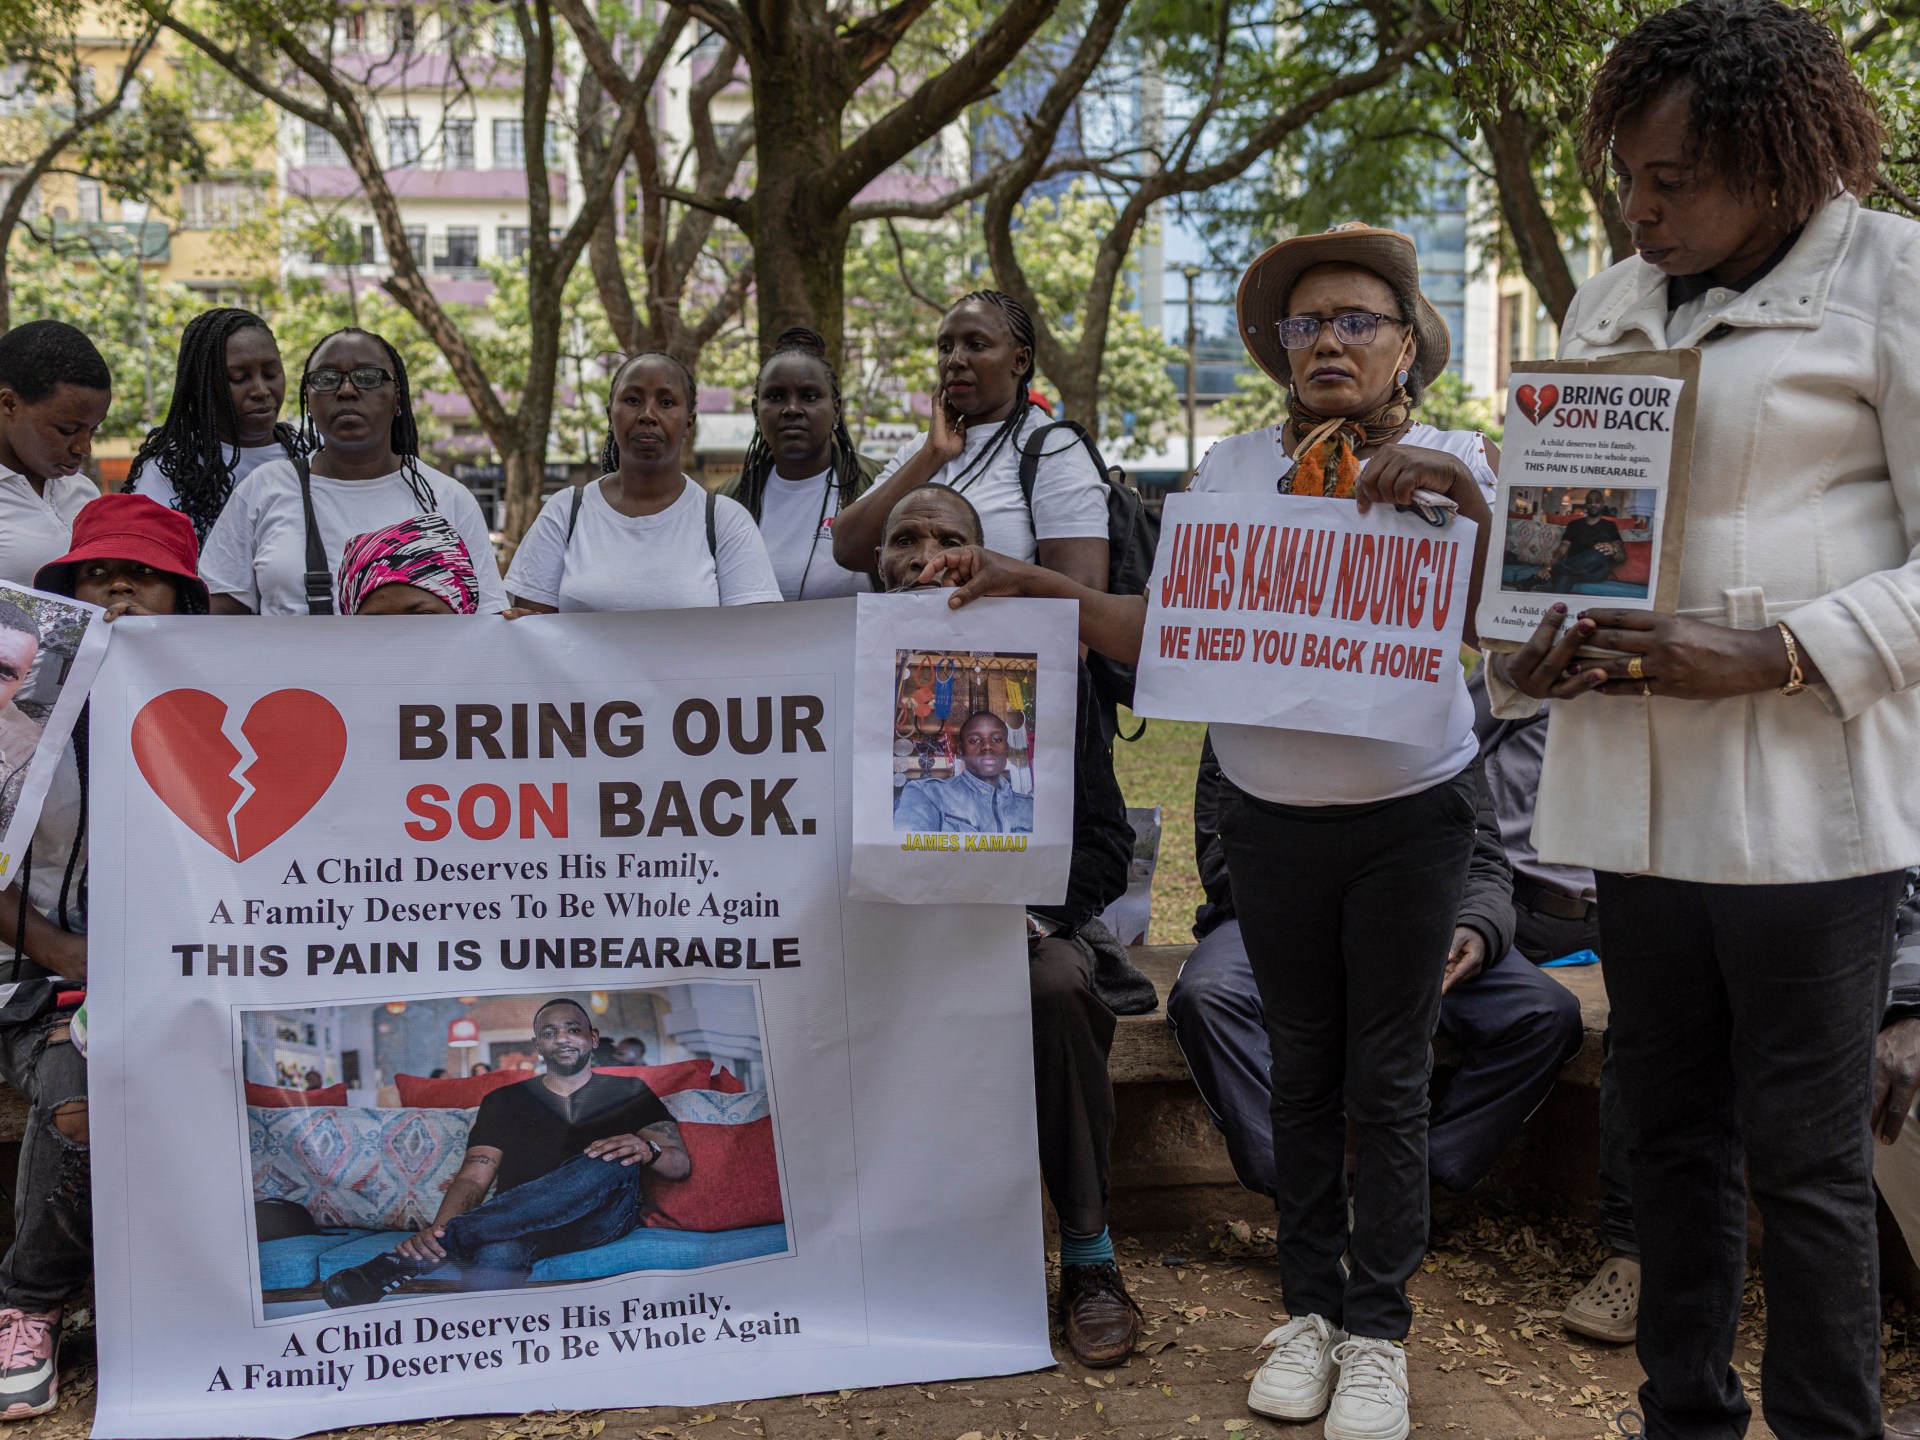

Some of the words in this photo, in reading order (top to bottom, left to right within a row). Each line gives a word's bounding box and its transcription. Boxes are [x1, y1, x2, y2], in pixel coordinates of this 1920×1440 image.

[1562, 386, 1624, 405] BRING
[1629, 388, 1671, 407] OUR
[1553, 408, 1598, 429] SON
[1603, 410, 1670, 432] BACK.
[1531, 449, 1553, 459] family
[1554, 450, 1584, 459] deserves
[1585, 452, 1593, 460] to
[1594, 452, 1603, 460] be
[1604, 453, 1627, 462] whole
[1629, 455, 1652, 464] again.
[1547, 439, 1565, 447] child
[1566, 440, 1597, 448] deserves
[1598, 441, 1609, 449] his
[1610, 441, 1637, 452] family.
[1524, 462, 1545, 472] THIS
[1546, 463, 1568, 473] PAIN
[1570, 464, 1579, 474] IS
[1580, 466, 1648, 477] UNBEARABLE.
[1161, 522, 1239, 611] JAMES
[1238, 524, 1336, 617] KAMAU
[1331, 532, 1459, 632] NDUNG'U
[1501, 617, 1526, 628] family
[1519, 606, 1539, 616] child
[1159, 625, 1191, 660] WE
[1194, 627, 1246, 662] NEED
[1252, 629, 1297, 666] YOU
[1300, 633, 1368, 673] BACK
[1370, 642, 1443, 683] HOME
[399, 701, 645, 760] BRING
[672, 695, 827, 756] OUR
[403, 782, 568, 841] SON
[600, 778, 817, 837] BACK.
[901, 834, 960, 852] JAMES
[965, 835, 1027, 852] KAMAU
[282, 859, 308, 885] A
[316, 858, 404, 885] Child
[414, 855, 548, 883] Deserves
[558, 854, 607, 879] His
[615, 852, 720, 886] Family.
[208, 899, 234, 924] A
[243, 898, 354, 930] Family
[363, 895, 501, 923] Deserves
[511, 894, 547, 919] To
[559, 892, 596, 919] Be
[603, 890, 690, 917] Whole
[698, 889, 780, 925] Again
[172, 943, 289, 977] THIS
[307, 940, 420, 976] PAIN
[438, 939, 482, 972] IS
[500, 936, 801, 971] UNBEARABLE
[280, 1332, 307, 1358] A
[315, 1320, 403, 1354] Child
[414, 1314, 550, 1343] Deserves
[560, 1304, 610, 1329] His
[621, 1292, 732, 1329] Family.
[206, 1365, 234, 1393] A
[242, 1359, 354, 1392] Family
[365, 1348, 503, 1382] Deserves
[512, 1339, 550, 1365] To
[561, 1334, 600, 1360] Be
[608, 1323, 706, 1354] Whole
[714, 1311, 801, 1343] Again
